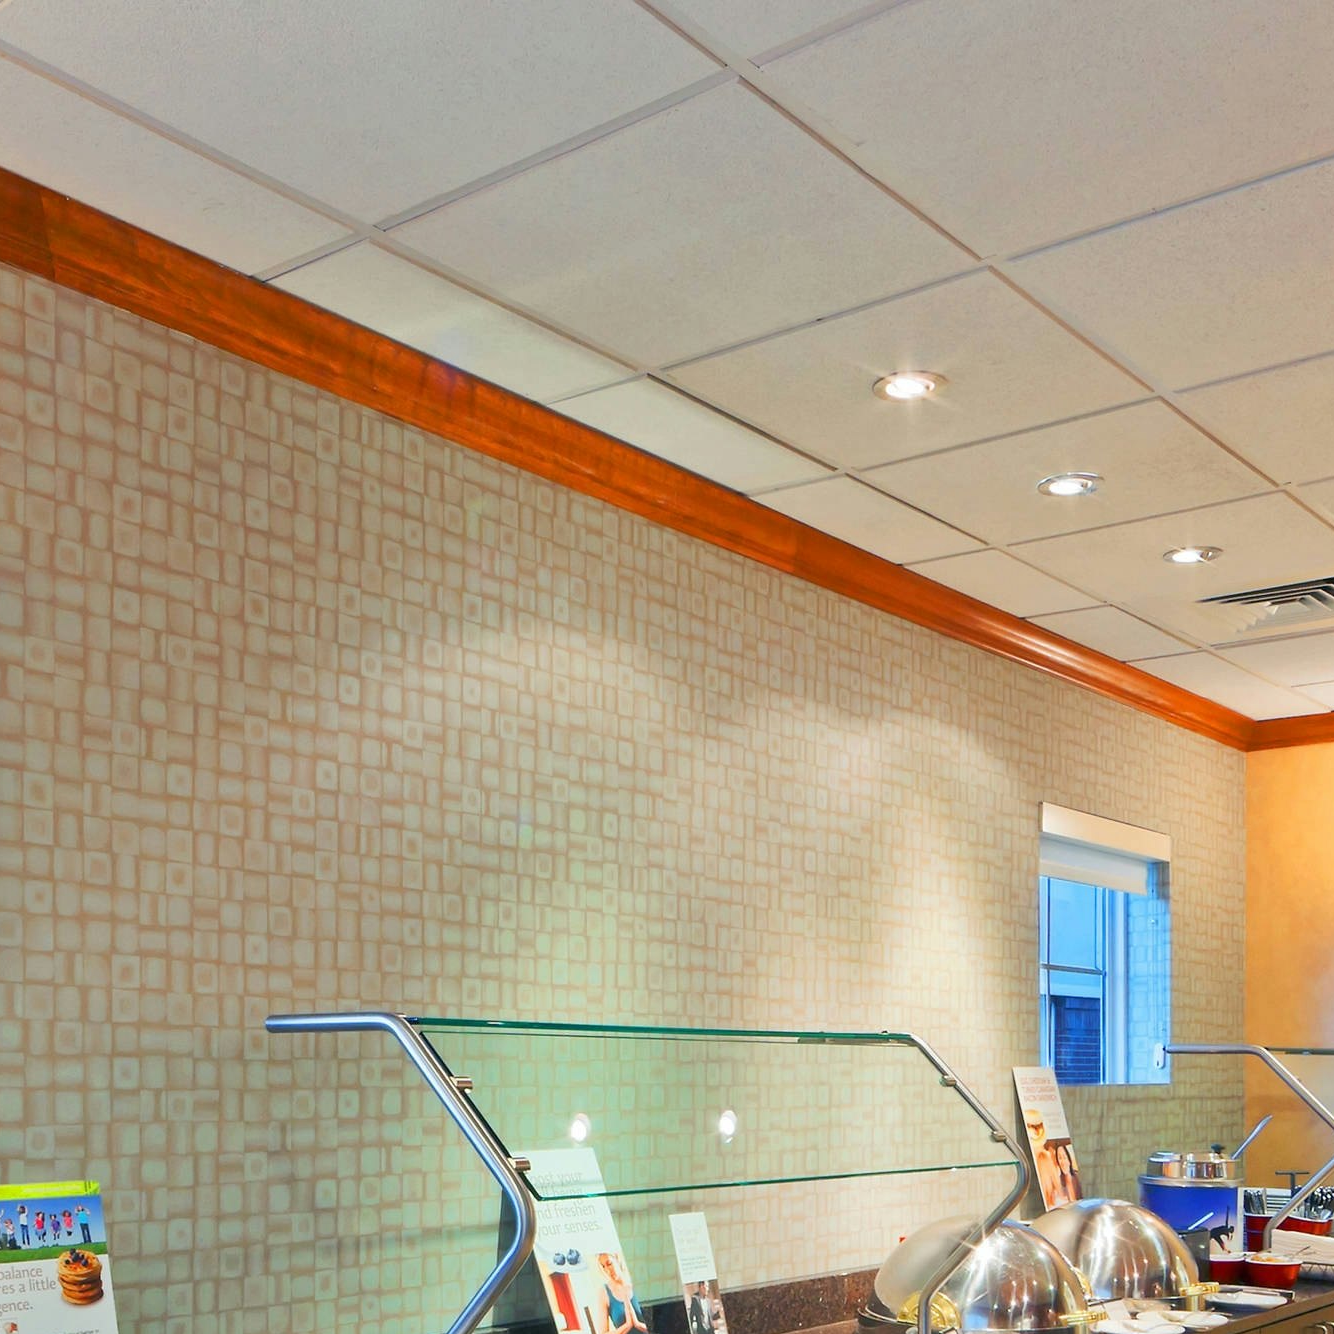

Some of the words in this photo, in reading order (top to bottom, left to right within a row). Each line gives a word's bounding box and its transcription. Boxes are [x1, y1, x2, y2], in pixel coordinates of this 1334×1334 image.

[554, 1201, 595, 1218] freshen
[19, 1283, 26, 1292] a
[29, 1278, 56, 1292] little
